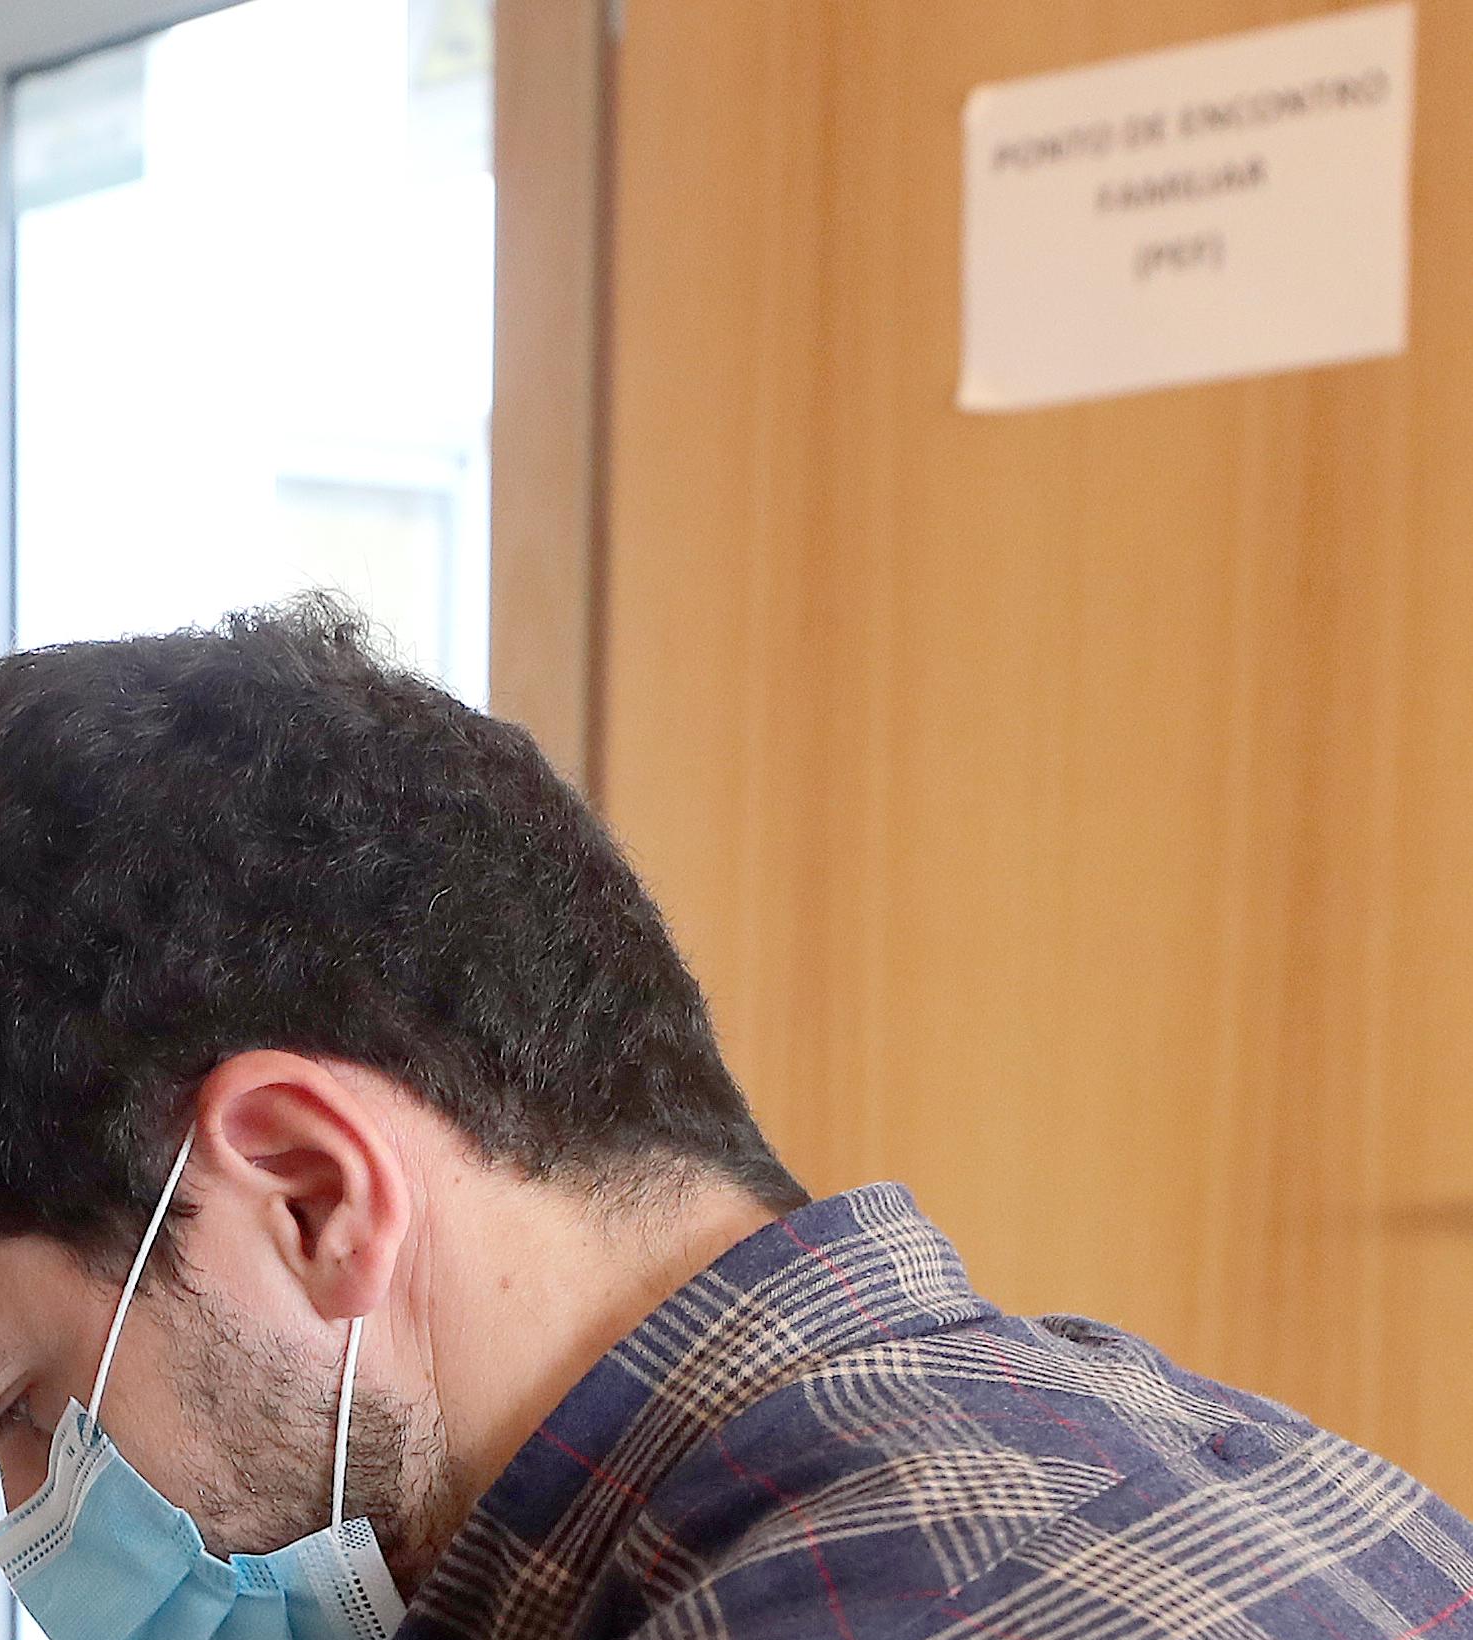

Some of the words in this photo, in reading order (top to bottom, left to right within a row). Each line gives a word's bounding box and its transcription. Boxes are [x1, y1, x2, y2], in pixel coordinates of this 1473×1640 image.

[991, 120, 1114, 173] PONTO
[1123, 111, 1167, 151] DE
[1178, 67, 1391, 138] ENCONTRO
[1093, 153, 1269, 213] FAMILIAR
